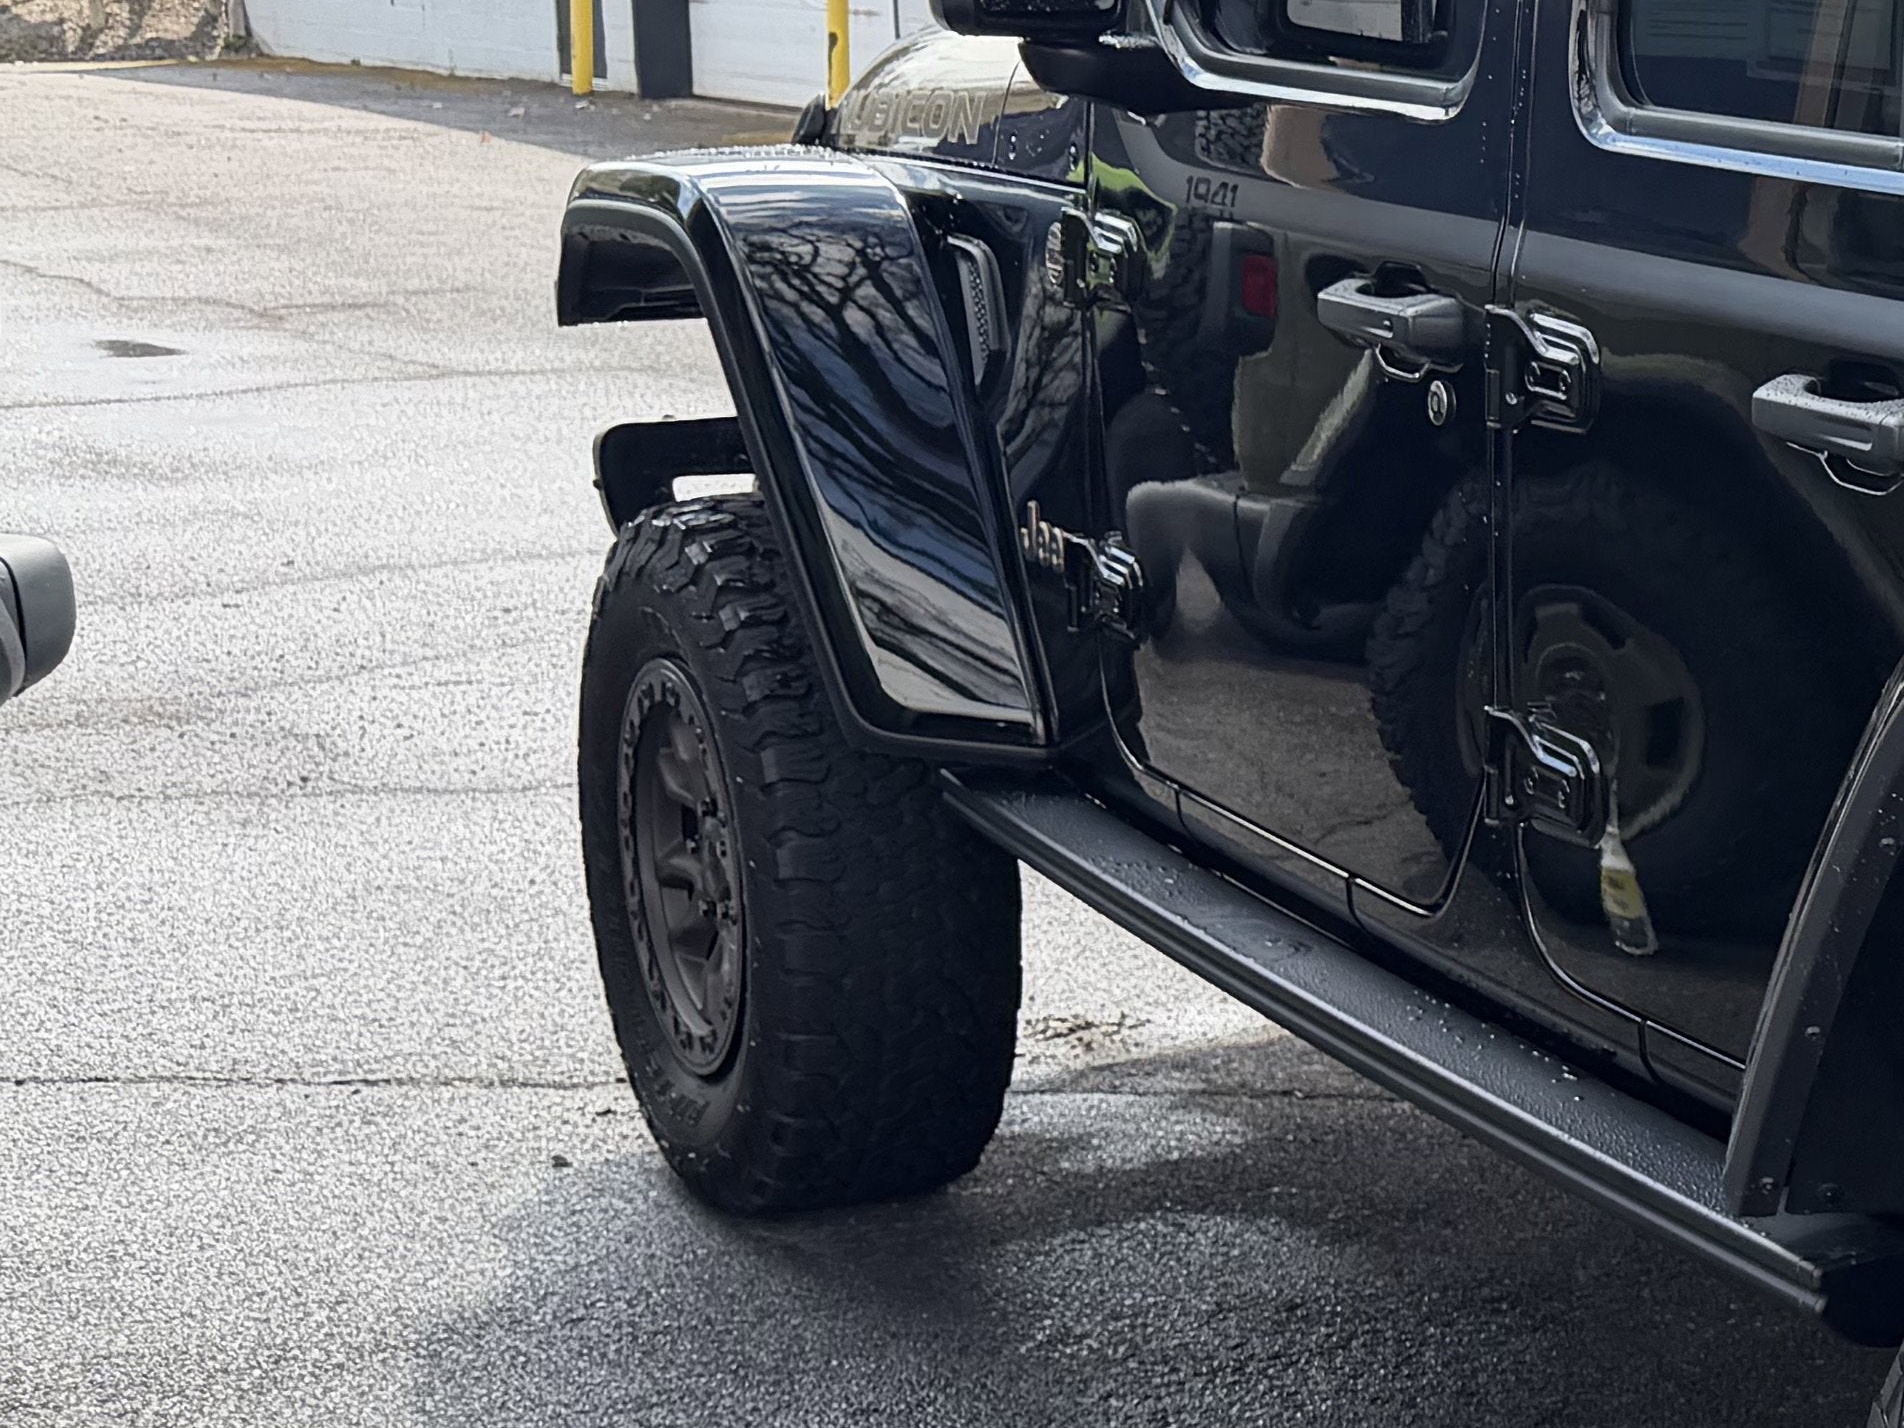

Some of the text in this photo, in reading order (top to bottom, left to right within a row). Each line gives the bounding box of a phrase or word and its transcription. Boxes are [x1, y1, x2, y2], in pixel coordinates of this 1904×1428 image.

[840, 88, 987, 145] UBICON
[1185, 175, 1240, 208] 1941
[1020, 499, 1065, 572] Jee
